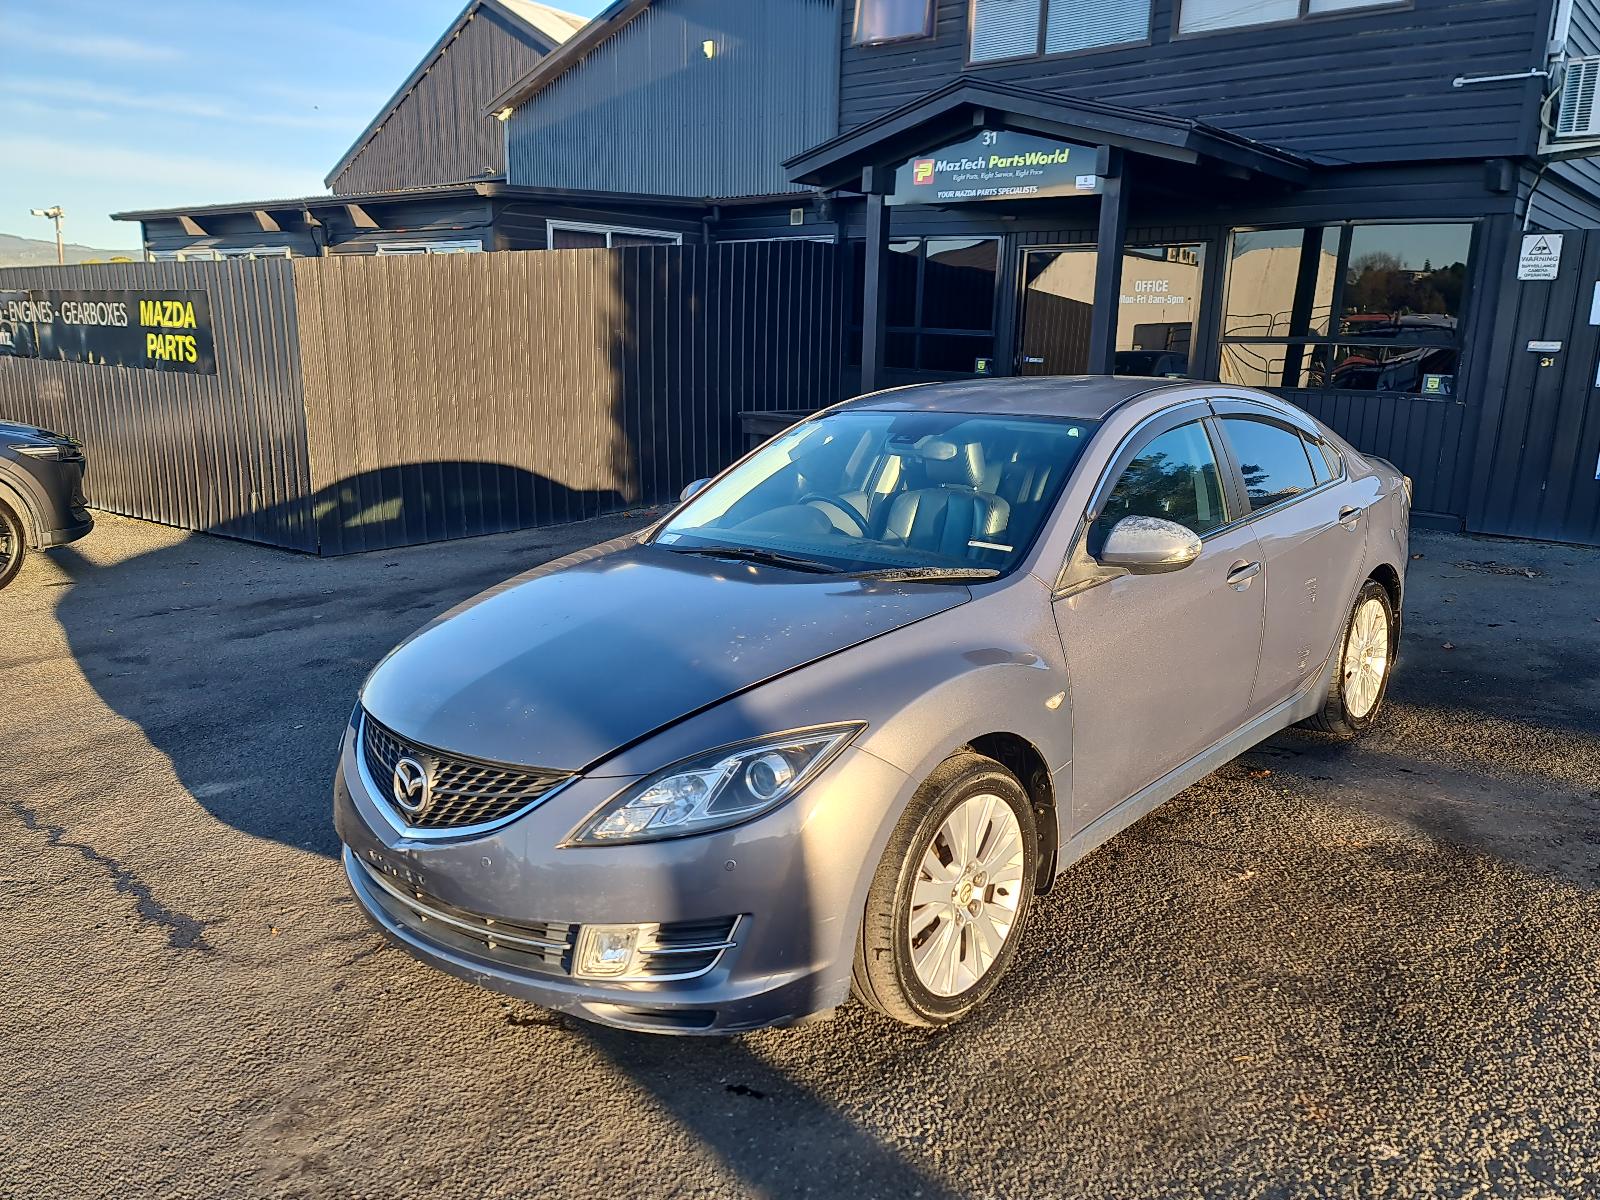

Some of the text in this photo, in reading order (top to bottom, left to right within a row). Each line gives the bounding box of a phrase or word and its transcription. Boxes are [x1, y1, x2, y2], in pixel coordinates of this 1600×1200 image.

[982, 131, 997, 145] 31
[935, 148, 1070, 172] MazTech PartsWorld
[937, 185, 1038, 198] YOUR MAZDA PARTS SPECIALISTS
[1135, 279, 1169, 292] OFFICE
[1148, 294, 1184, 305] 8am-5pm
[8, 300, 53, 323] ENGINES
[61, 301, 128, 327] GEARBOXES
[139, 300, 197, 329] MAZDA
[146, 333, 198, 363] PARTS
[1540, 357, 1554, 367] 31
